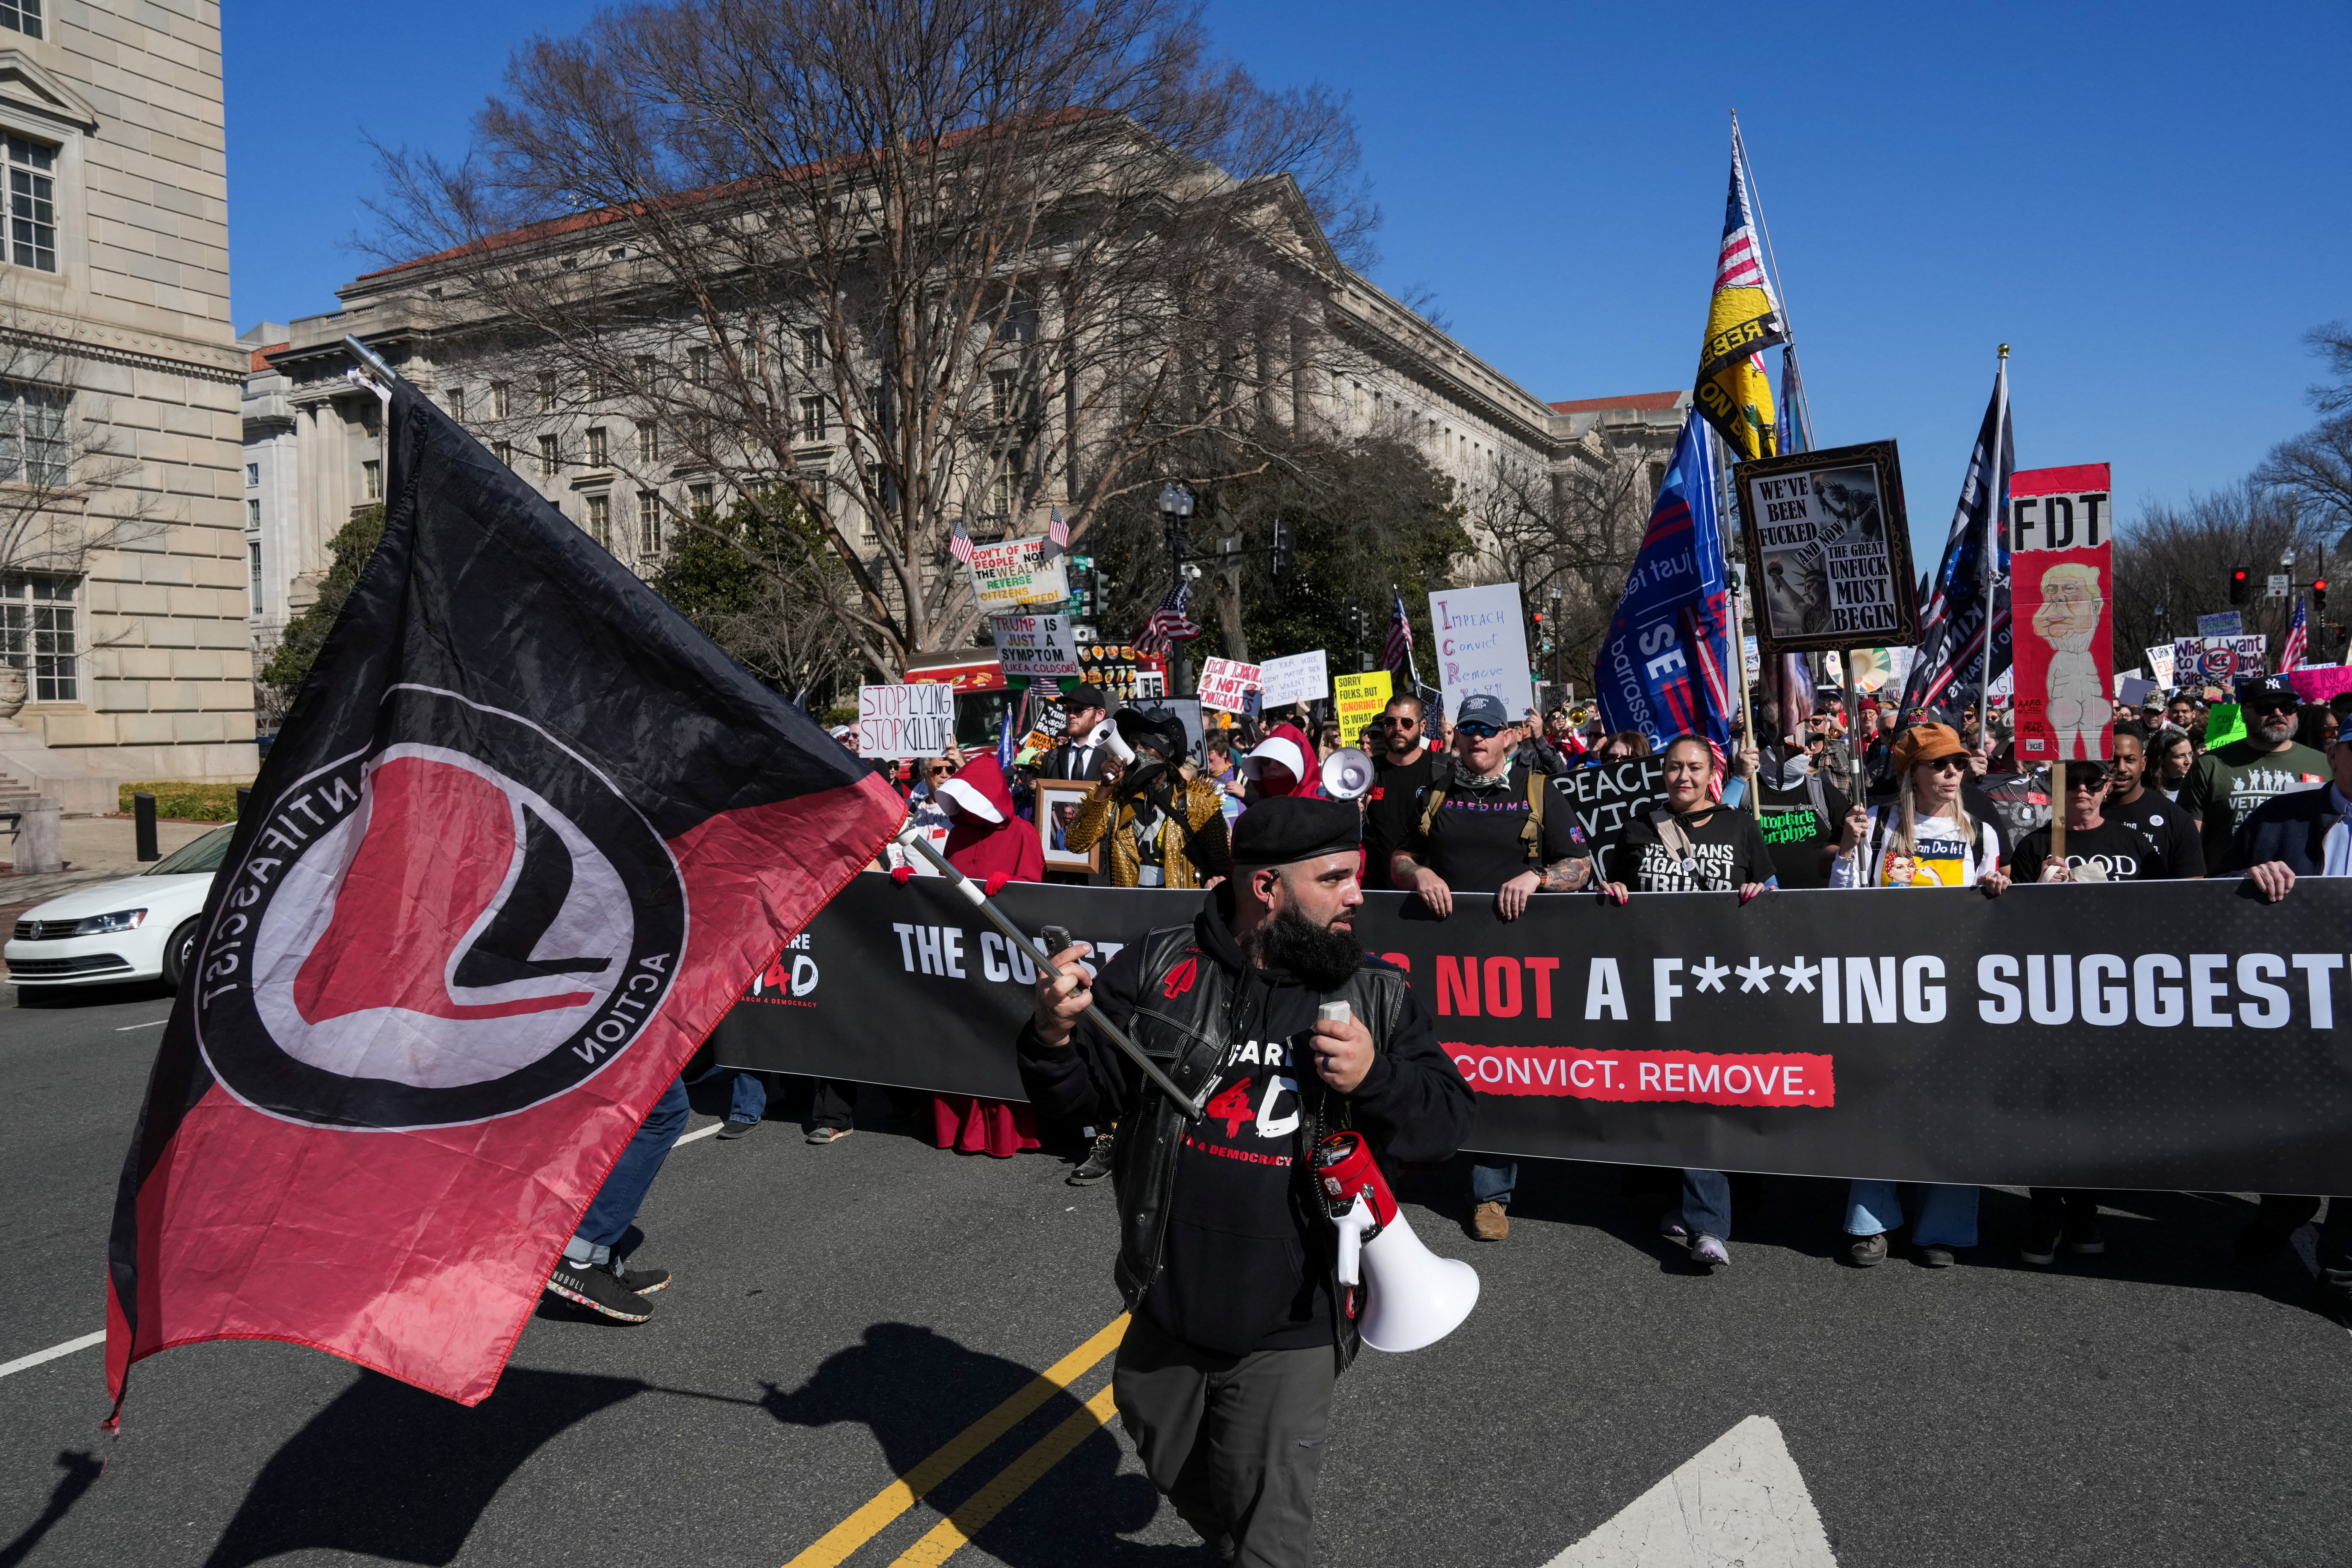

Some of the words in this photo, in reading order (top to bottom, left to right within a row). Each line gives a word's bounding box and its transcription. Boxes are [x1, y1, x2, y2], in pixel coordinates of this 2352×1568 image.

[1758, 476, 1808, 501] WE'VE
[1767, 499, 1807, 522] BEEN
[2015, 494, 2107, 550] FDT
[1758, 522, 1817, 546] FUCKED
[1797, 541, 1820, 565] AND
[1817, 520, 1847, 548] NOW
[972, 548, 1000, 560] GOV'T
[1006, 545, 1019, 555] OF
[1024, 541, 1045, 552] THE
[1023, 551, 1045, 562] NOT
[1827, 545, 1848, 558] THE
[1850, 542, 1884, 556] GREAT
[975, 569, 996, 579] THE
[996, 559, 1055, 577] WEALTHY
[1829, 556, 1890, 580] UNFUCK
[987, 575, 1032, 590] REVERSE
[981, 587, 1029, 601] CITIZENS
[1016, 590, 1059, 605] UNITED!
[1835, 579, 1887, 605] MUST
[993, 617, 1036, 632] TRUMP
[1044, 619, 1057, 632] IS
[1438, 600, 1504, 631] IMPEACH
[1832, 604, 1896, 632] BEGIN
[1008, 634, 1035, 647] JUST
[1046, 634, 1055, 647] A
[1443, 633, 1498, 656] Convict
[2175, 638, 2207, 657] What
[1002, 648, 1064, 661] SYMPTOM
[2148, 647, 2169, 661] TURN
[2176, 656, 2193, 670] to
[2208, 653, 2228, 667] ICE
[1206, 659, 1229, 675] FIGHT
[1230, 662, 1262, 683] IGNORANC
[1279, 659, 1295, 669] YOUR
[1285, 668, 1304, 678] MATTER
[1308, 664, 1320, 673] THEN
[1445, 661, 1504, 685] Remove
[1265, 685, 1274, 694] THEY
[1308, 675, 1321, 683] TRY
[1339, 676, 1361, 687] SORRY
[2320, 667, 2349, 686] NO
[1216, 678, 1244, 694] NOT
[1265, 696, 1273, 704] TO
[1278, 688, 1303, 701] SILENCE
[1307, 686, 1316, 696] IT
[1340, 689, 1363, 700] FOLKS,
[1364, 687, 1377, 697] BUT
[863, 686, 907, 716] STOP
[909, 684, 951, 715] LYING
[1200, 689, 1253, 712] IMMIGRANTS
[1341, 700, 1376, 712] IGNORING
[1378, 699, 1383, 708] IT
[1040, 714, 1067, 729] Fascis
[1048, 706, 1067, 723] Trum
[1342, 716, 1349, 725] IS
[1351, 713, 1371, 723] WHAT
[861, 718, 902, 751] STOP
[904, 717, 951, 750] KILLING
[1344, 727, 1356, 737] THE
[1443, 800, 1529, 811] REEDUMB
[1761, 824, 1817, 845] urphys
[1644, 843, 1734, 860] VERANS
[1932, 841, 1947, 853] Do
[1950, 842, 1962, 854] It!
[2046, 854, 2136, 875] OOD
[785, 933, 810, 950] RE
[754, 953, 818, 997] 4D
[893, 923, 966, 979] THE
[1436, 955, 1559, 1019] NOT
[1585, 958, 1628, 1020] A
[1977, 953, 2352, 1029] SUGGEST
[771, 998, 817, 1008] DEMOCRACY
[1454, 1054, 1625, 1090] CONVICT.
[1640, 1062, 1815, 1096] REMOVE.
[1209, 1144, 1293, 1166] DEMOCRACY
